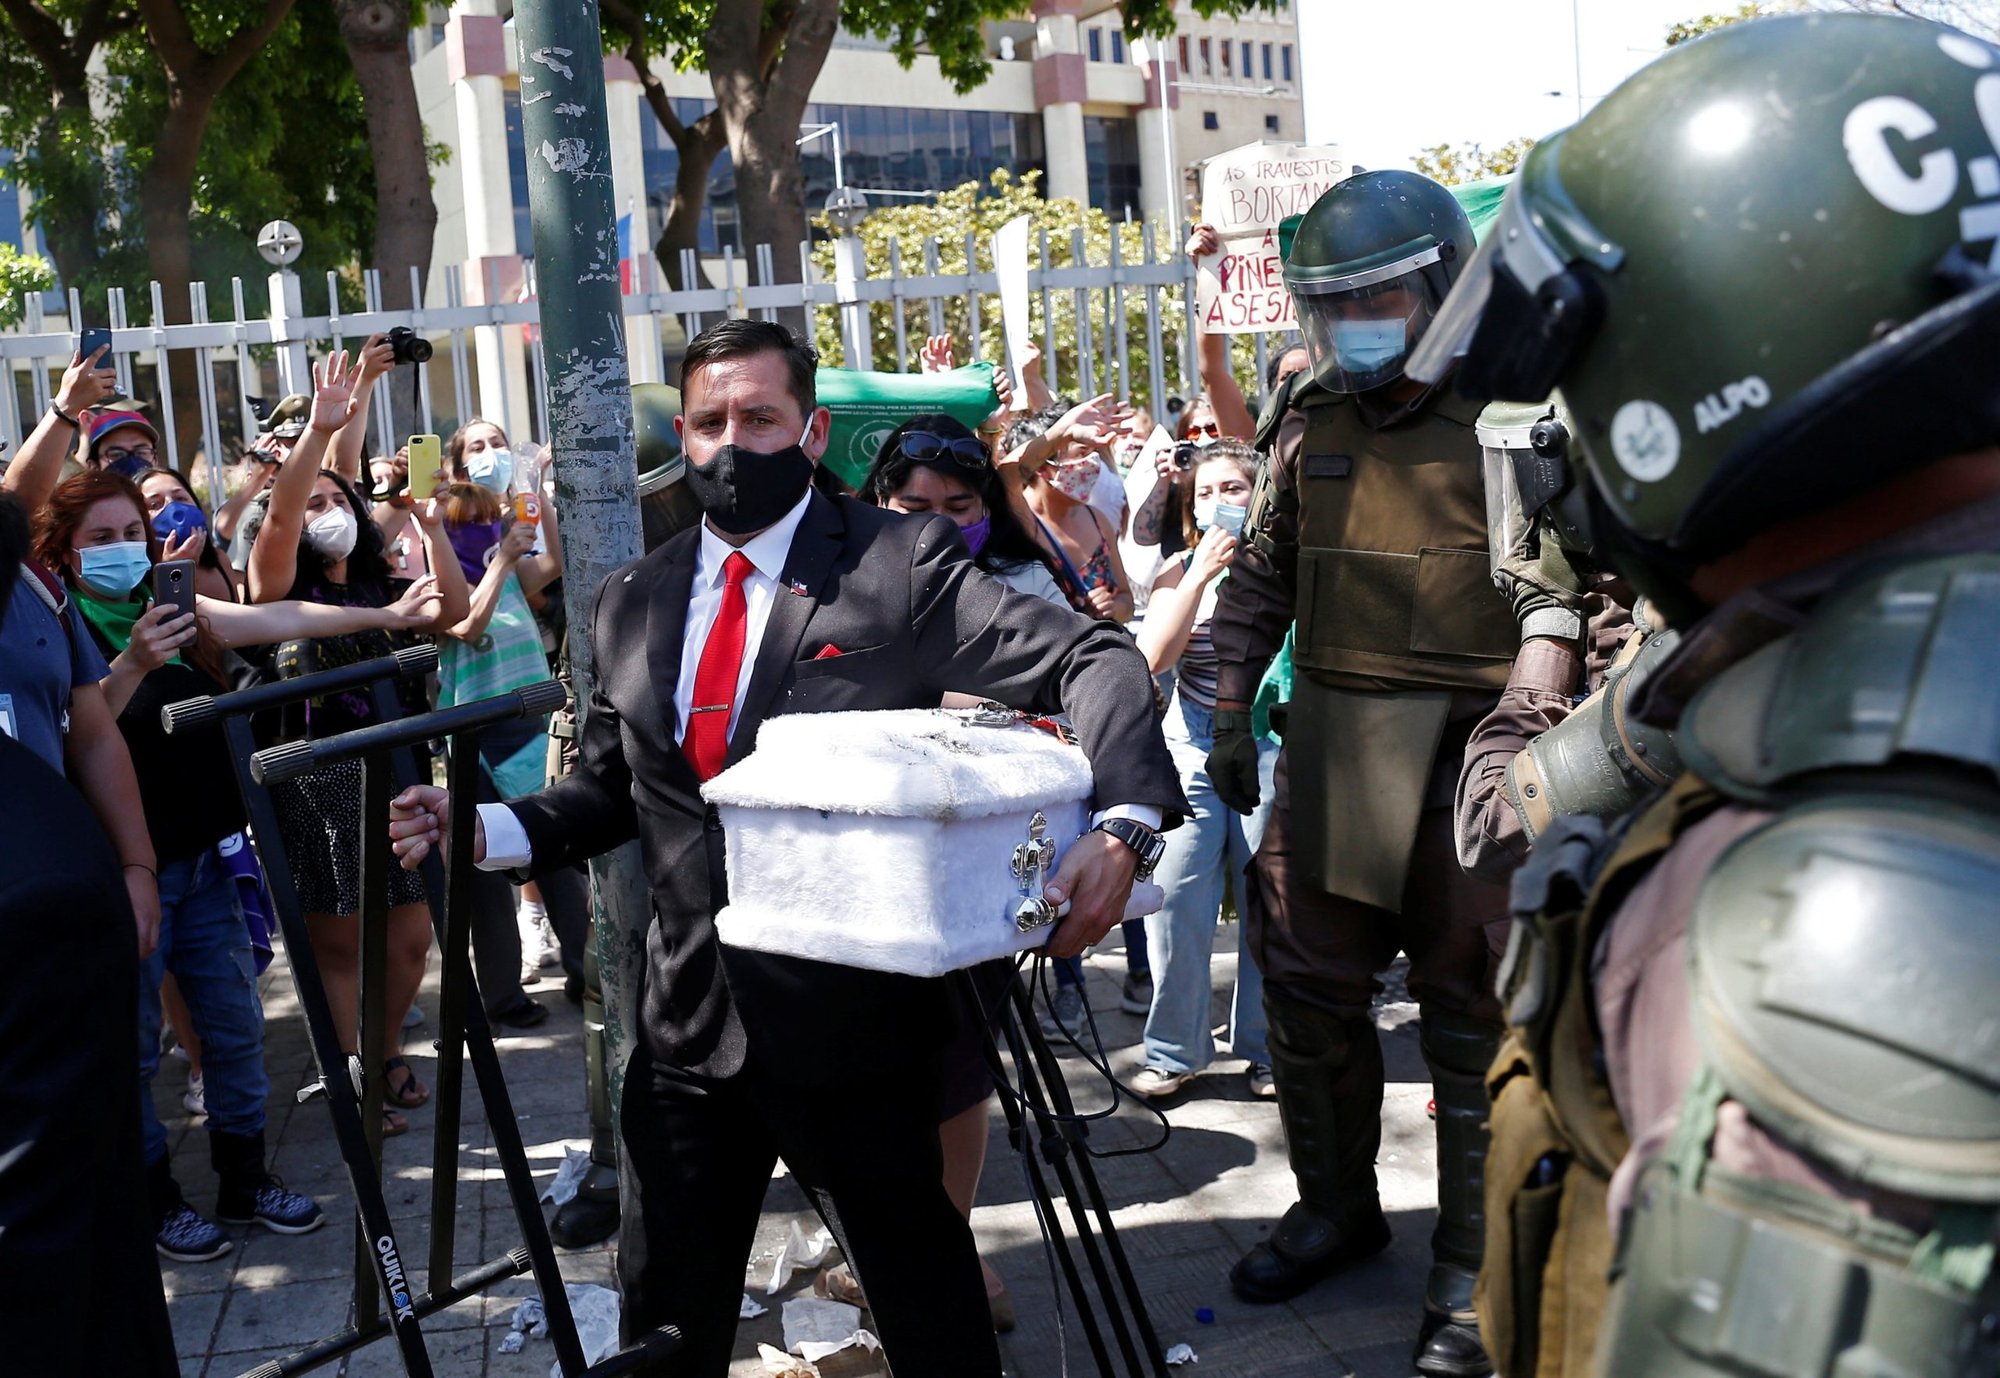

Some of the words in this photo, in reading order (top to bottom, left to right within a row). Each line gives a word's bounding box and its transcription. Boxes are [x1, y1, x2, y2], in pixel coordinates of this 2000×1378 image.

[1262, 228, 1275, 249] A
[1206, 291, 1298, 327] ASESI
[1693, 375, 1772, 434] ALPO
[377, 1235, 415, 1323] QUIKLOK
